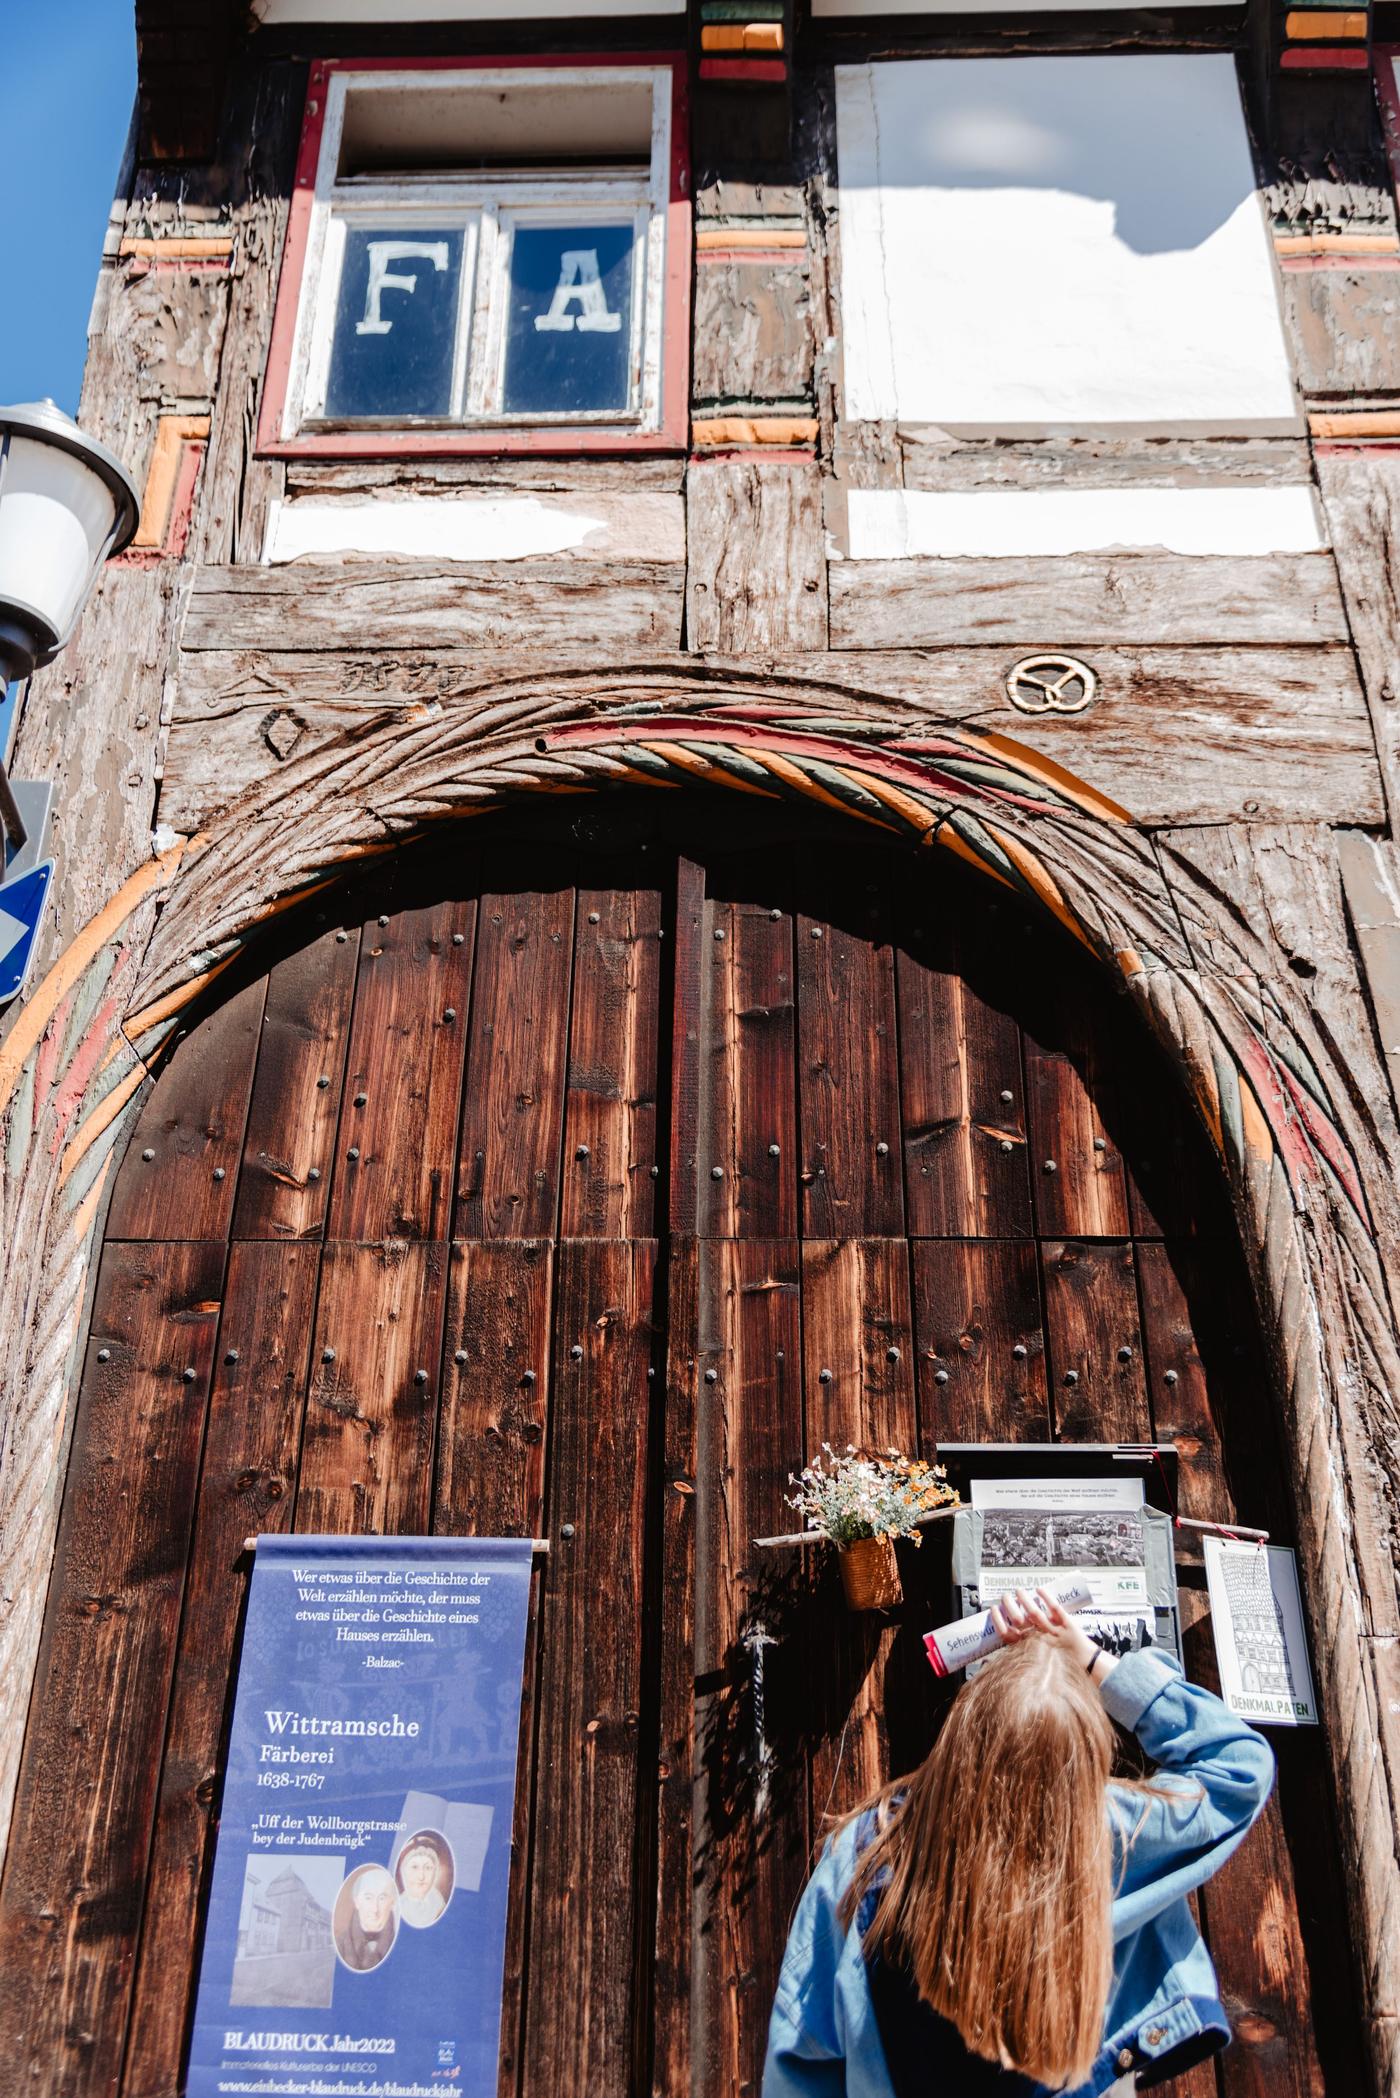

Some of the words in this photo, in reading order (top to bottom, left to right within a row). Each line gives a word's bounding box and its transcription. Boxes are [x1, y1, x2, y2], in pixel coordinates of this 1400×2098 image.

[355, 241, 449, 335] F
[534, 249, 622, 332] A
[293, 1569, 318, 1584] Wer
[319, 1573, 353, 1584] etwas
[356, 1571, 383, 1584] über
[385, 1572, 402, 1585] die
[405, 1572, 468, 1586] Geschichte
[471, 1574, 490, 1586] der
[1117, 1582, 1139, 1590] KFE
[298, 1589, 326, 1602] Welt
[328, 1591, 377, 1603] erzählen
[380, 1591, 426, 1606] möchte,
[429, 1592, 449, 1604] der
[451, 1594, 481, 1605] muss
[295, 1610, 330, 1622] etwas
[333, 1608, 359, 1622] über
[362, 1609, 380, 1622] die
[383, 1609, 446, 1623] Geschichte
[449, 1612, 479, 1624] eines
[336, 1627, 379, 1641] Hauses
[381, 1628, 434, 1642] erzählen.
[361, 1656, 405, 1668] -Balzac-
[1231, 1694, 1309, 1716] DENKMALPATEN
[264, 1711, 420, 1737] Wittramsche
[260, 1745, 334, 1764] Färberei
[257, 1773, 325, 1789] 1638-1767
[282, 1817, 304, 1829] der
[307, 1815, 407, 1833] Wollborgstrasse
[253, 1834, 273, 1847] bey
[276, 1834, 296, 1845] der
[223, 2031, 329, 2051] BLAUDRUCK
[341, 2062, 377, 2073] UNESCO
